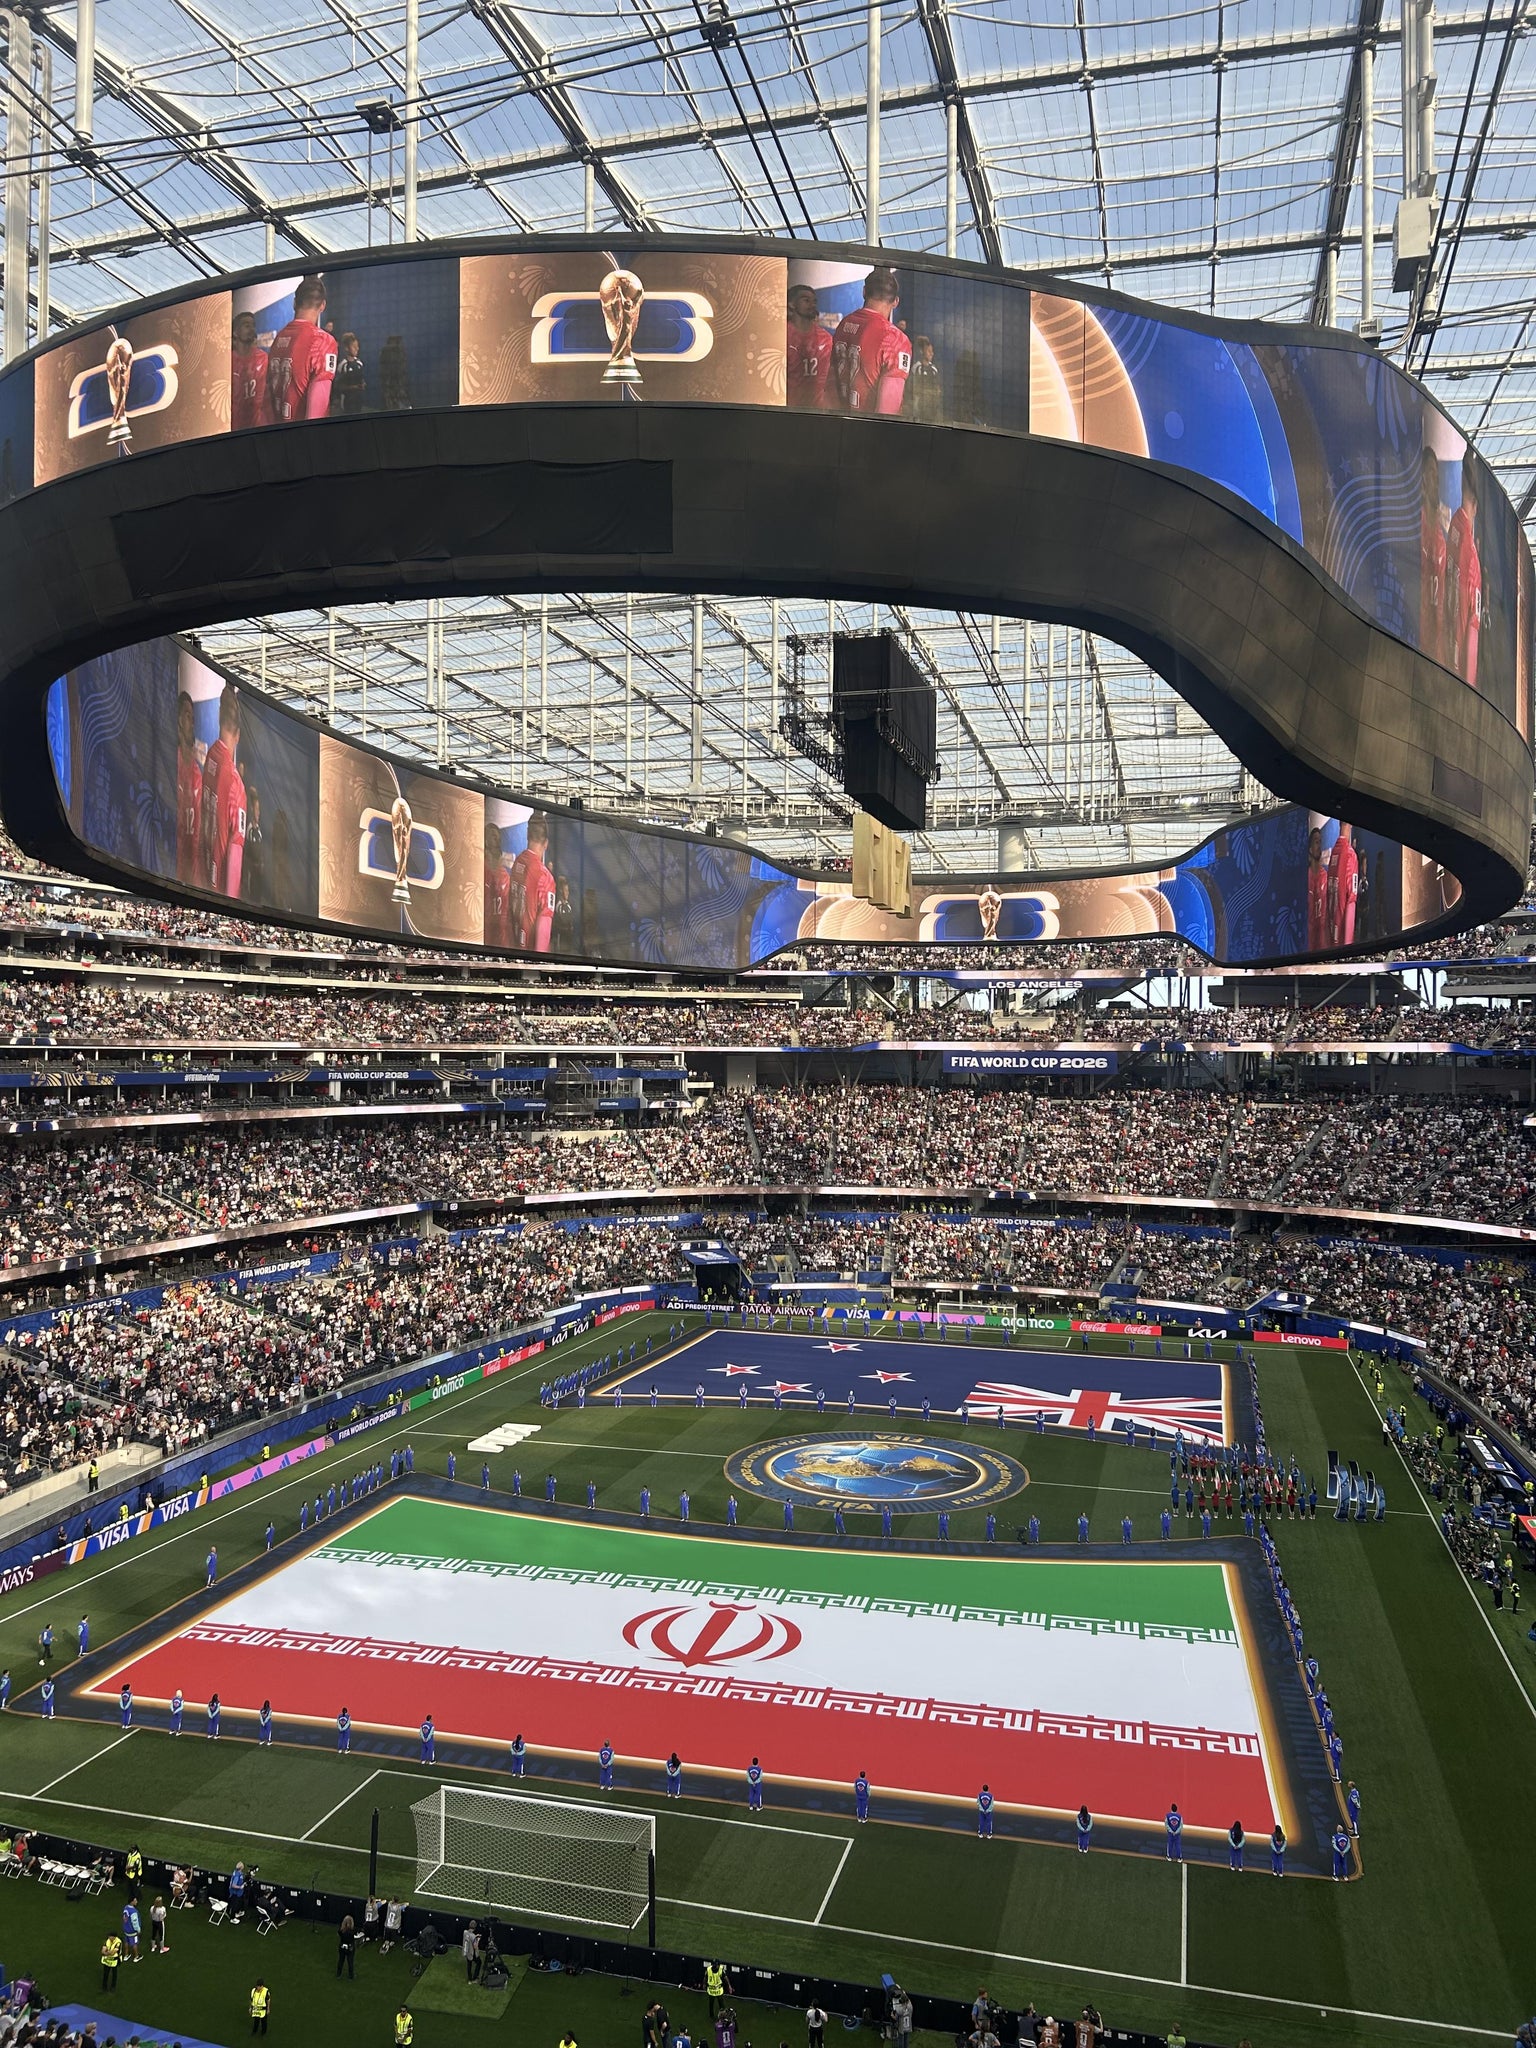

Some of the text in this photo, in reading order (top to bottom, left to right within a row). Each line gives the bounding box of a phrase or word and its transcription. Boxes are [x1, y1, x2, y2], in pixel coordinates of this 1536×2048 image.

[802, 357, 818, 377] 12
[244, 379, 256, 399] 12
[988, 981, 1083, 989] LOS ANGELES
[951, 1056, 1107, 1069] FIFA WORLD CUP 2026
[328, 1071, 409, 1080] FIFA WORLD CUP 2026
[637, 1215, 679, 1223] ANGELES
[1014, 1218, 1029, 1226] CUP
[1030, 1219, 1056, 1227] 2026
[1335, 1239, 1354, 1247] LOS
[239, 1270, 253, 1280] FIFA
[254, 1265, 277, 1276] WORLD
[277, 1262, 289, 1272] CUP
[667, 1302, 734, 1312] ADI PREDICTSTREET
[740, 1304, 815, 1316] QATAR AIRWAYS
[844, 1308, 871, 1319] VISA
[1001, 1316, 1054, 1329] aramco
[1188, 1328, 1228, 1339] KIA
[1281, 1333, 1322, 1345] Lenovo
[432, 1376, 465, 1400] aramco
[338, 1408, 398, 1440] FIFA WORLD CUP 2026
[874, 1434, 925, 1444] FIFA
[160, 1497, 190, 1522] VISA
[816, 1499, 876, 1511] FIFA
[97, 1523, 130, 1551] VISA
